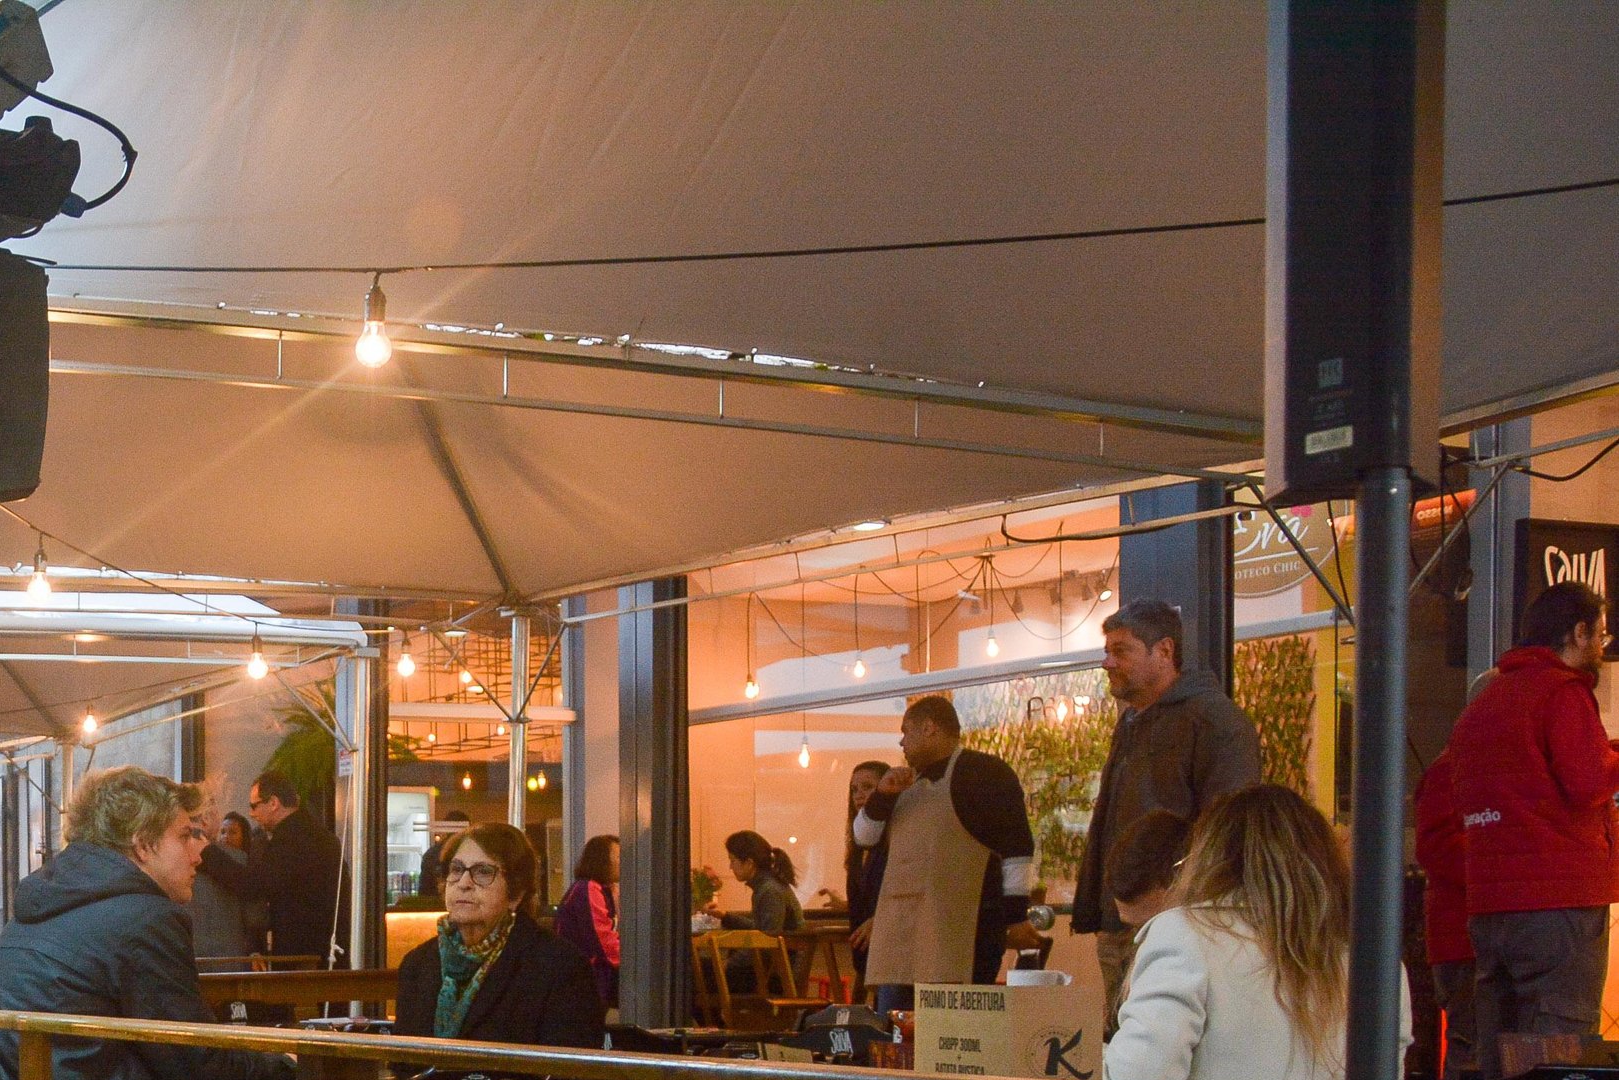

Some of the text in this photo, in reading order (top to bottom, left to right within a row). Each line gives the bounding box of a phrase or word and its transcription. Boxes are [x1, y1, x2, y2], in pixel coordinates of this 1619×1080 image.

[919, 989, 1006, 1012] PROMO DE ABERTURA
